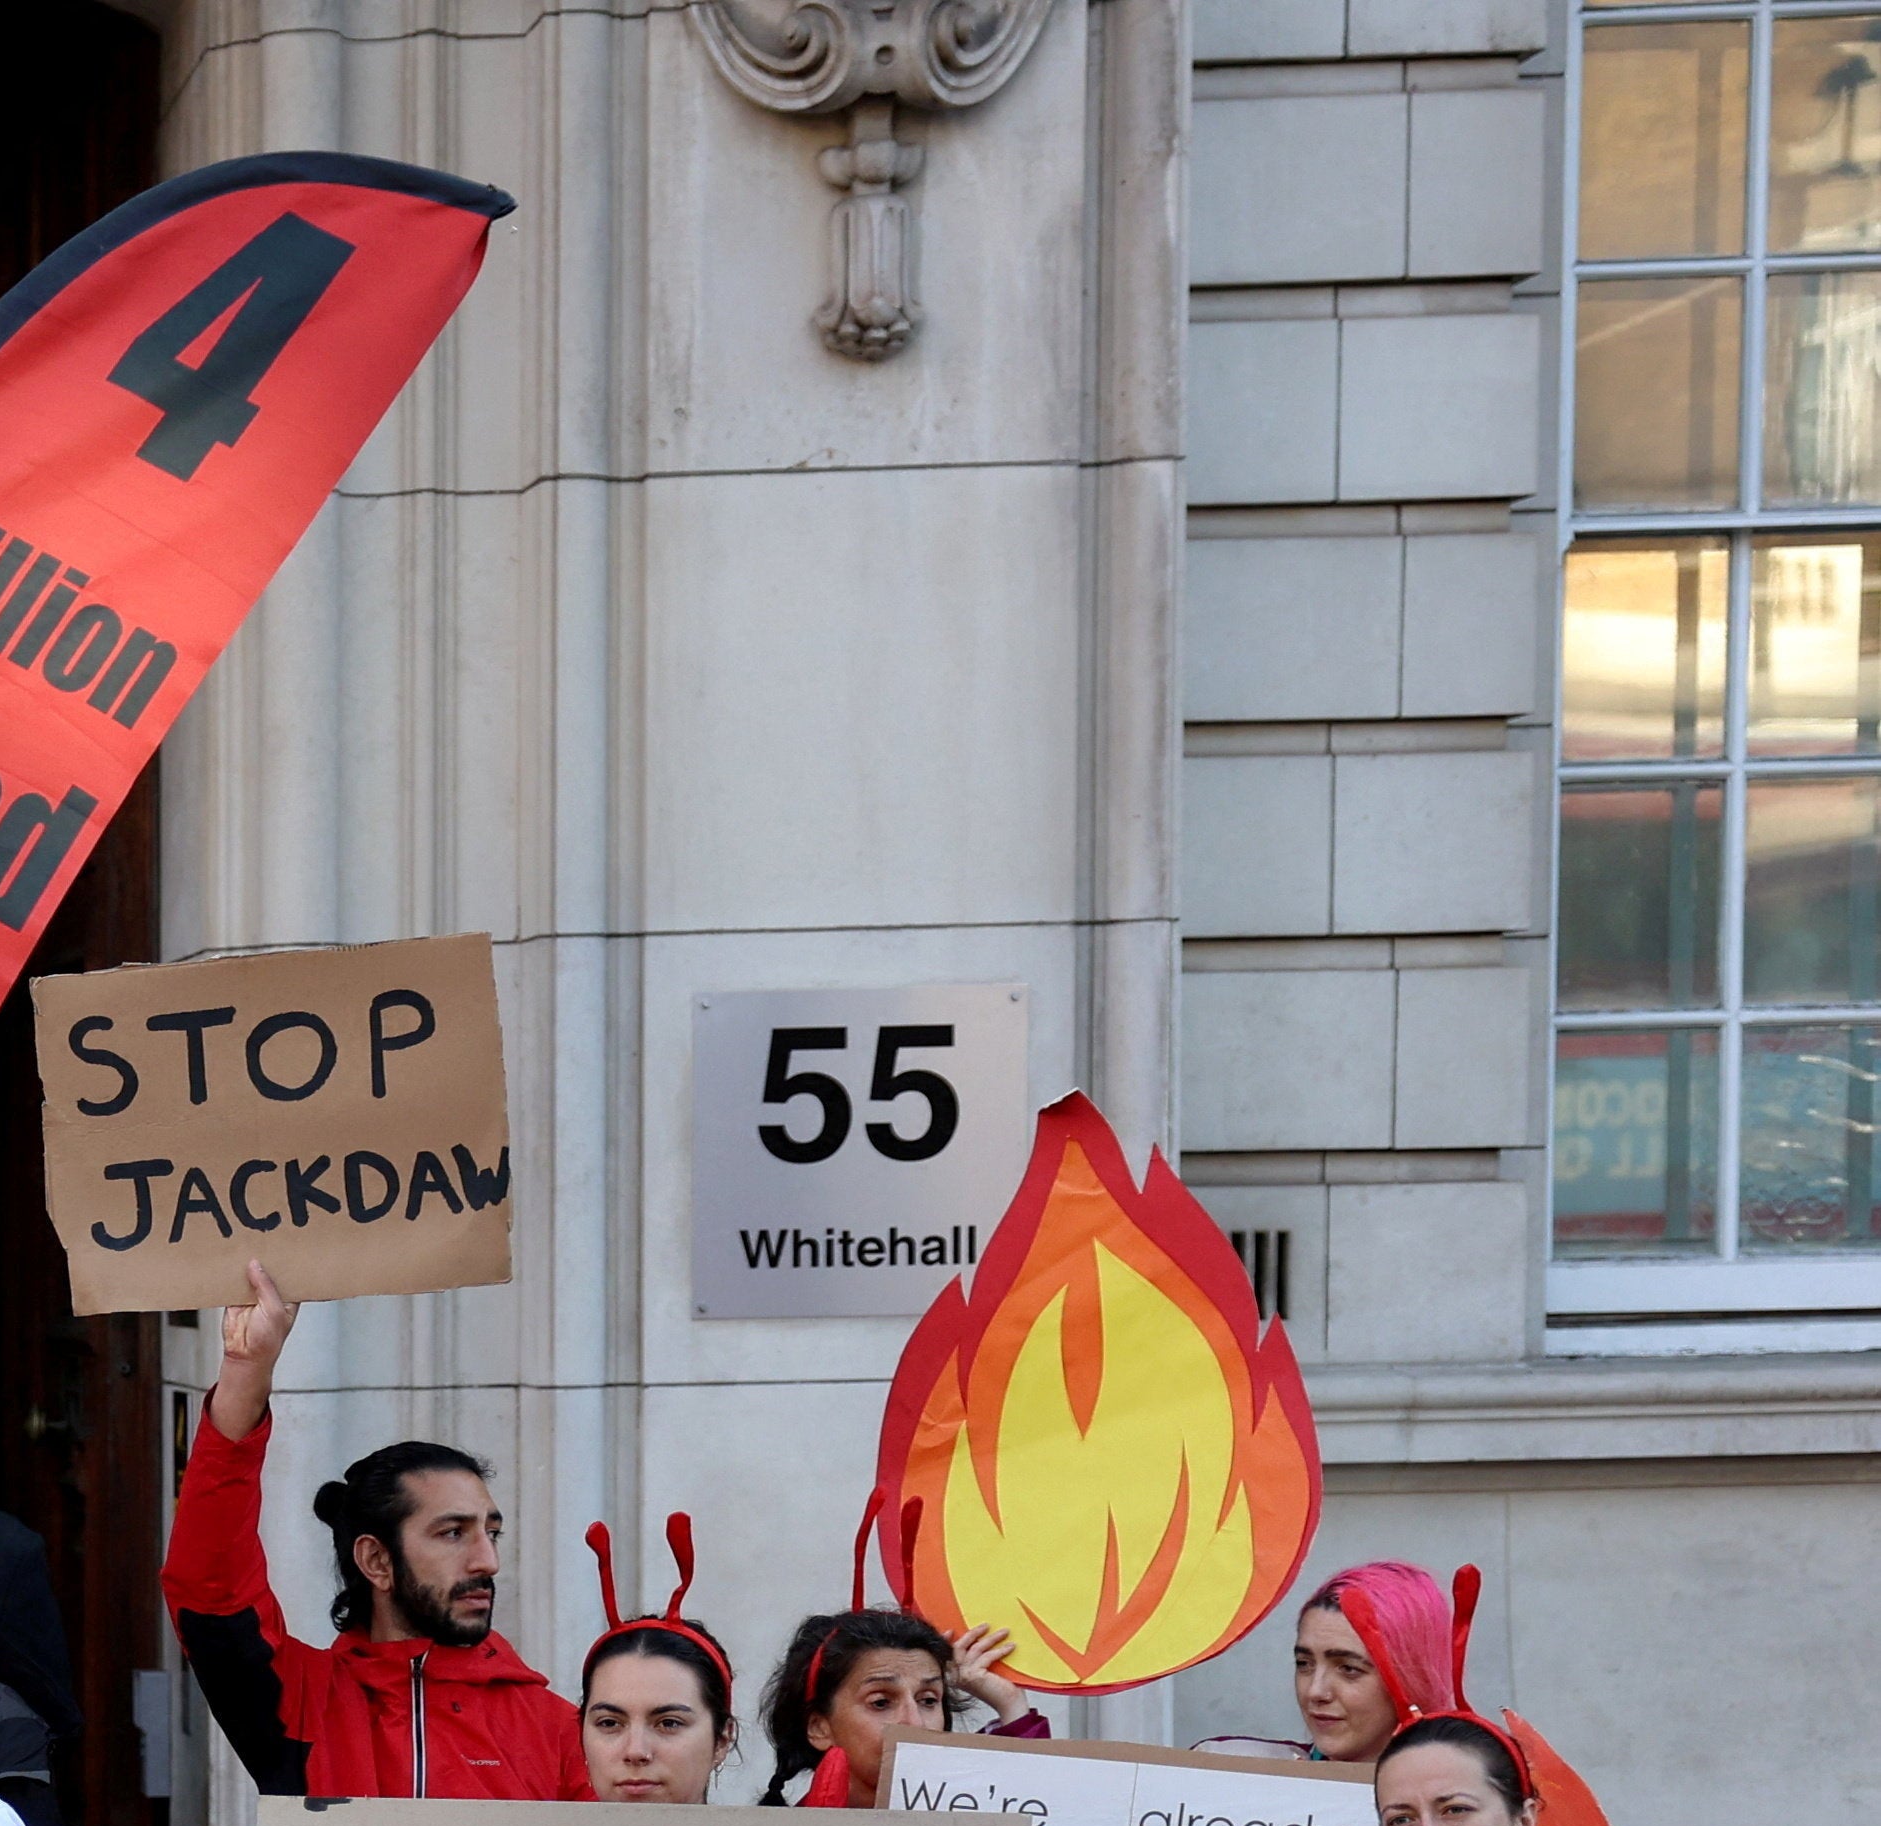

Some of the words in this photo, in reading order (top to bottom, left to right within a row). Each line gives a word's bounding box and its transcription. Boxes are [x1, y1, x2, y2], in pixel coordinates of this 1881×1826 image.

[106, 211, 356, 482] 4
[68, 988, 436, 1117] STOP
[758, 1024, 960, 1165] 55
[90, 1143, 511, 1252] JACKDAW
[739, 1225, 978, 1269] Whitehall
